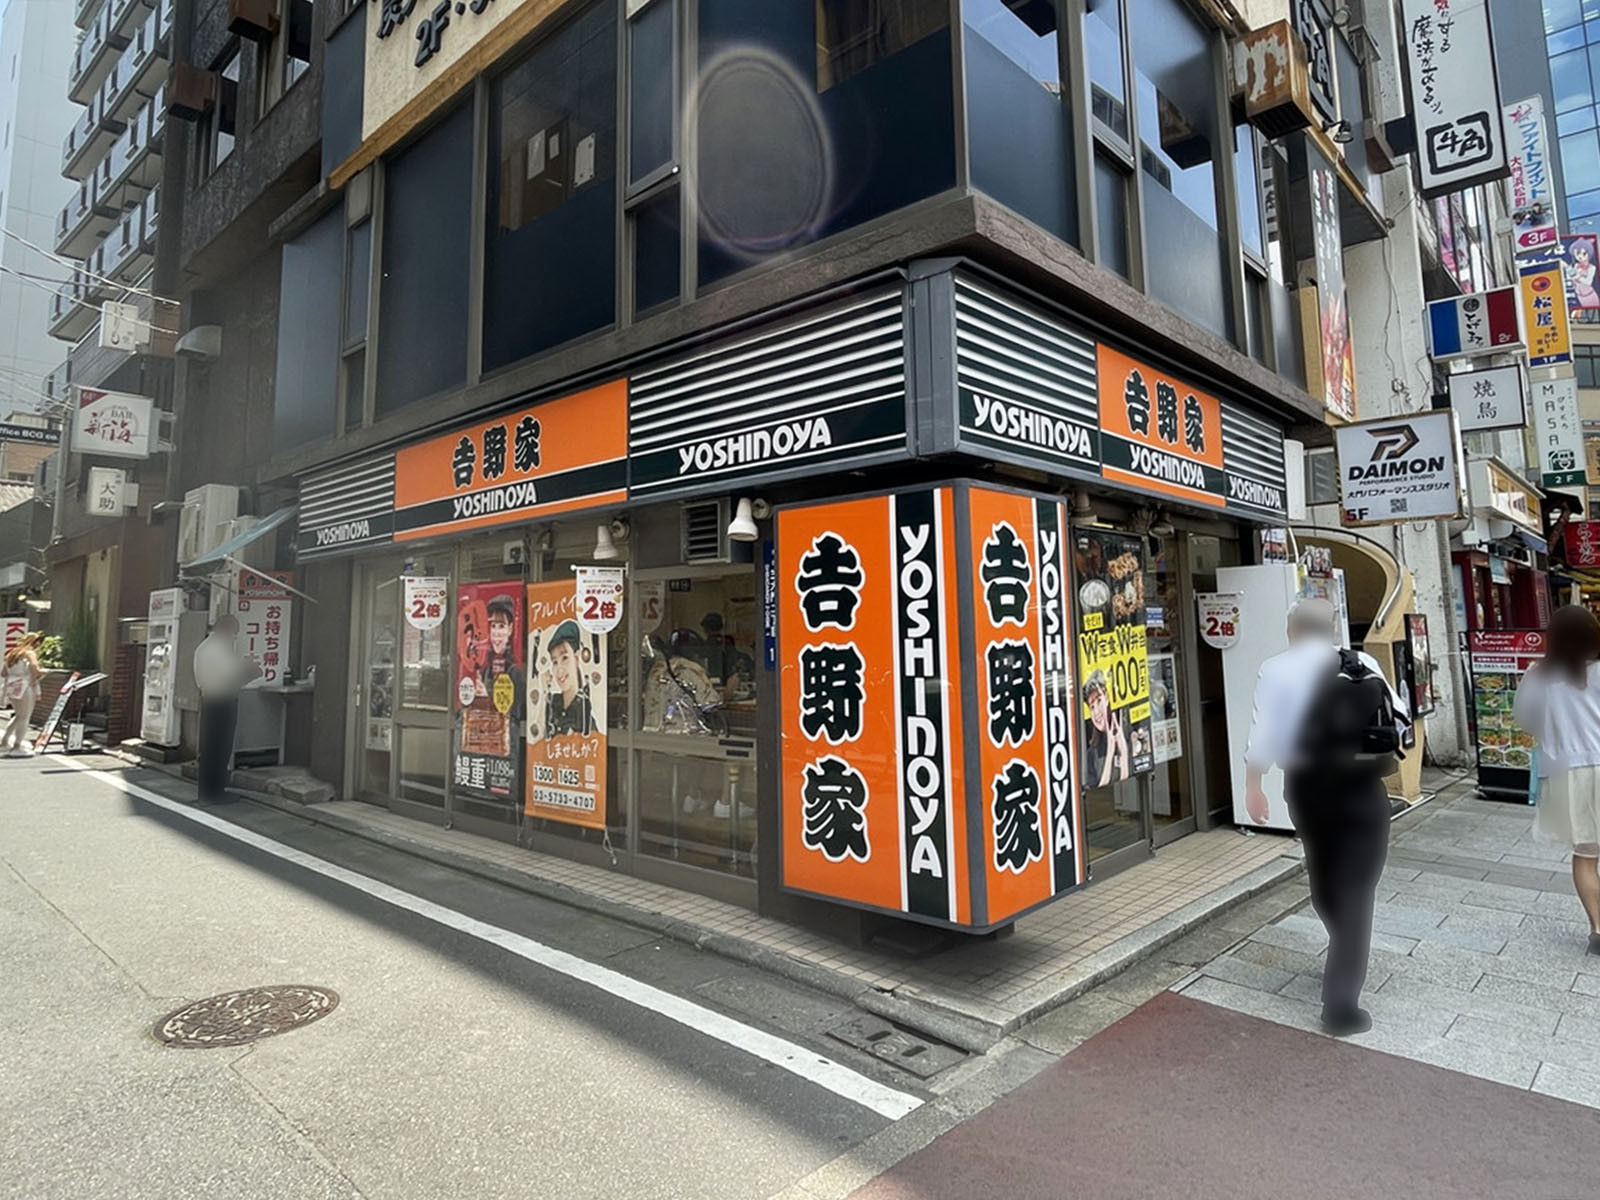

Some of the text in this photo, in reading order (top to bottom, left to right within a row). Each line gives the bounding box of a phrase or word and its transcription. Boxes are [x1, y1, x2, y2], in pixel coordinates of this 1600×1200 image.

[1437, 128, 1485, 157] 牛角
[1528, 231, 1548, 245] 3F
[1533, 295, 1553, 327] 松屋
[1543, 355, 1557, 364] 1F
[1124, 368, 1206, 454] 吉野家
[1473, 378, 1498, 420] 焼鳥
[1542, 384, 1559, 446] MASA
[973, 394, 1092, 458] YOSHINOYA
[451, 414, 541, 490] 吉野家
[678, 416, 832, 475] YOSHINOYA
[1130, 444, 1206, 489] YOSHINOYA
[1348, 456, 1445, 481] DAIMON
[1554, 474, 1574, 484] 2F
[99, 482, 117, 511] 大助
[453, 482, 537, 519] YOSHINOYA
[1228, 474, 1282, 510] YOSHINOYA
[1346, 507, 1369, 521] 5F
[316, 519, 370, 546] YOSHINOYA
[411, 600, 441, 619] 2倍
[583, 596, 617, 619] 2倍
[264, 605, 282, 682] お持ち帰り
[1206, 617, 1236, 636] 2倍
[795, 530, 871, 863] 吉野家
[900, 523, 942, 878] YOSHINOYA
[979, 520, 1044, 875] 吉野家
[1040, 530, 1072, 855] YOSHINOYA
